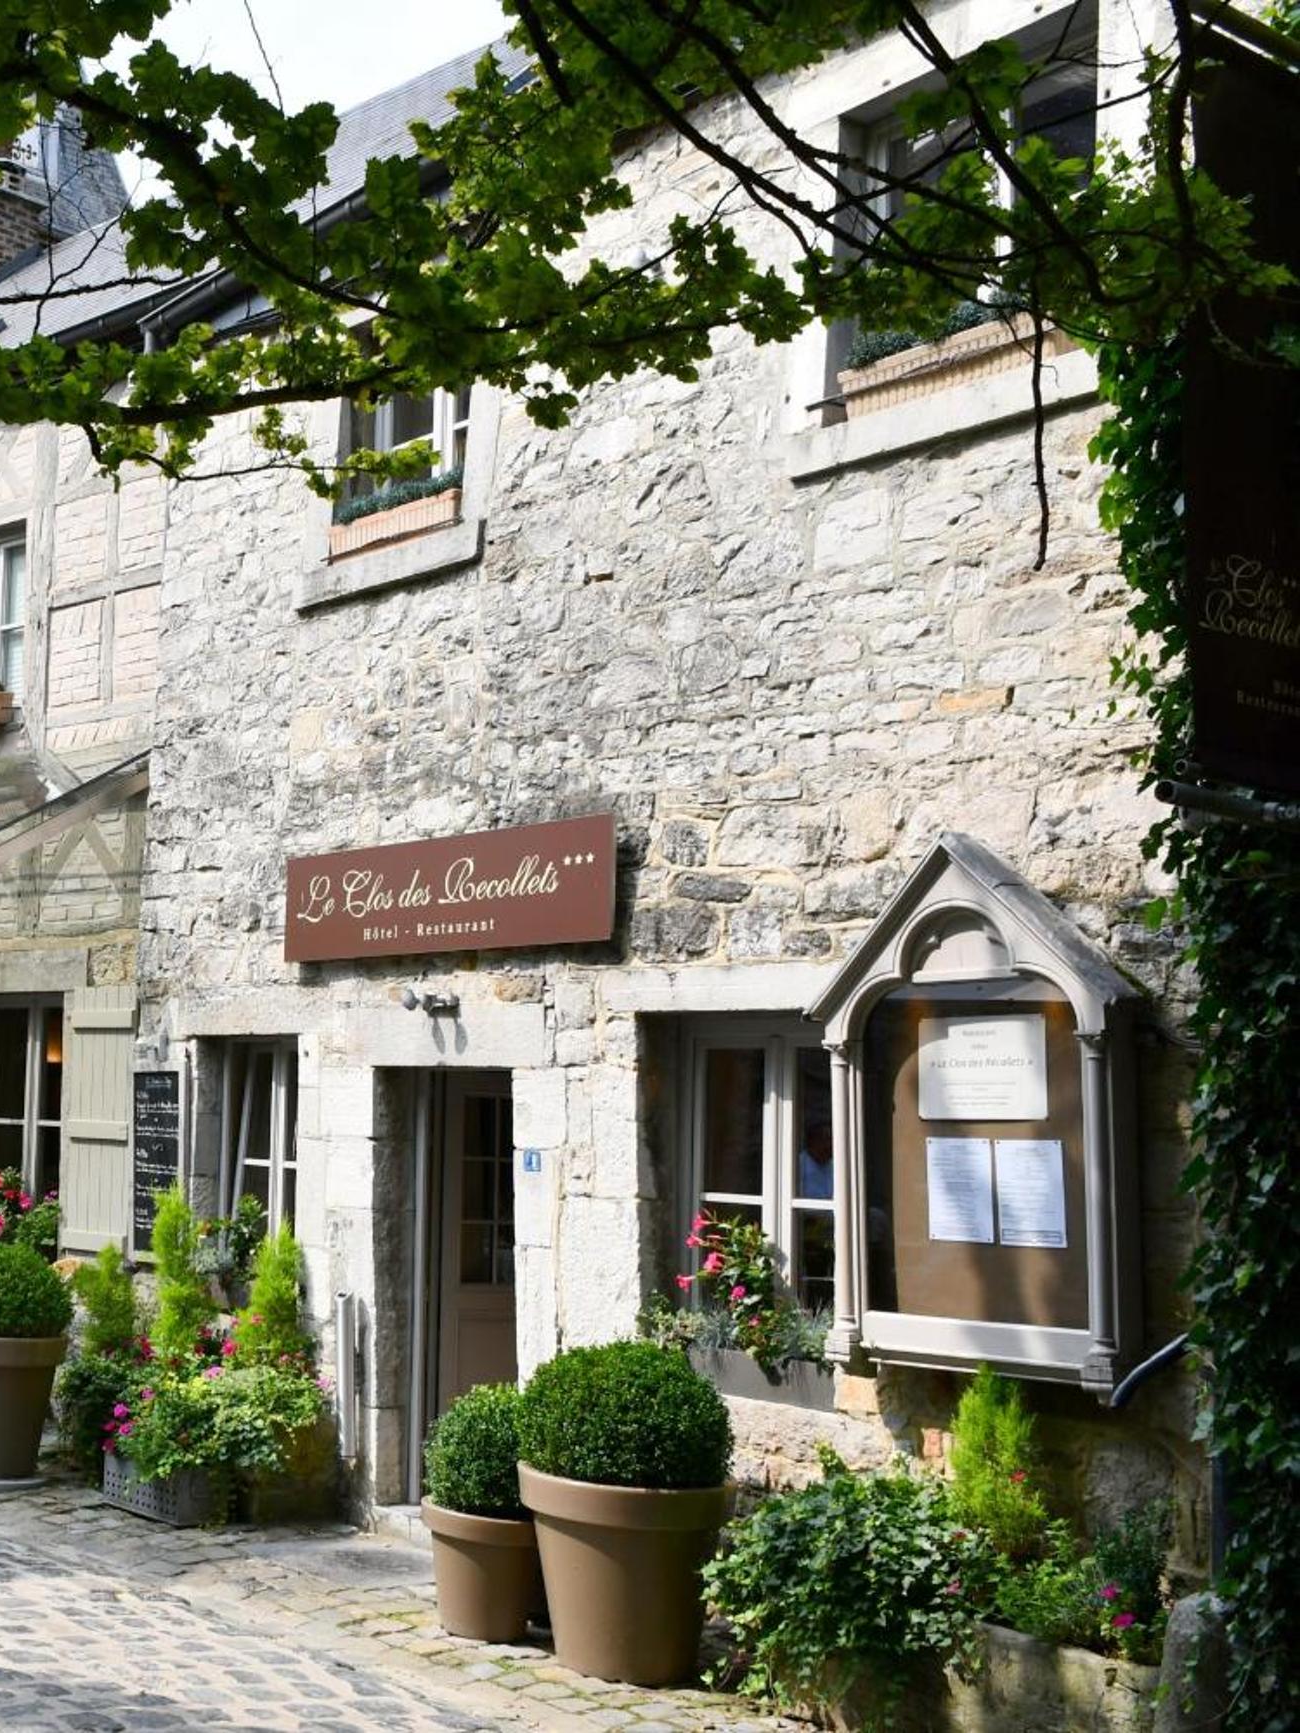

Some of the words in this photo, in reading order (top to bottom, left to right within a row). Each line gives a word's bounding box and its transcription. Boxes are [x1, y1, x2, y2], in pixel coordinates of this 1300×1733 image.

[1226, 553, 1283, 608] Clos
[297, 874, 336, 923] Le
[342, 869, 394, 918] Clos
[398, 869, 432, 908] des
[438, 854, 560, 904] Recollets
[363, 924, 398, 941] Hôtel
[417, 917, 496, 937] Restaurant
